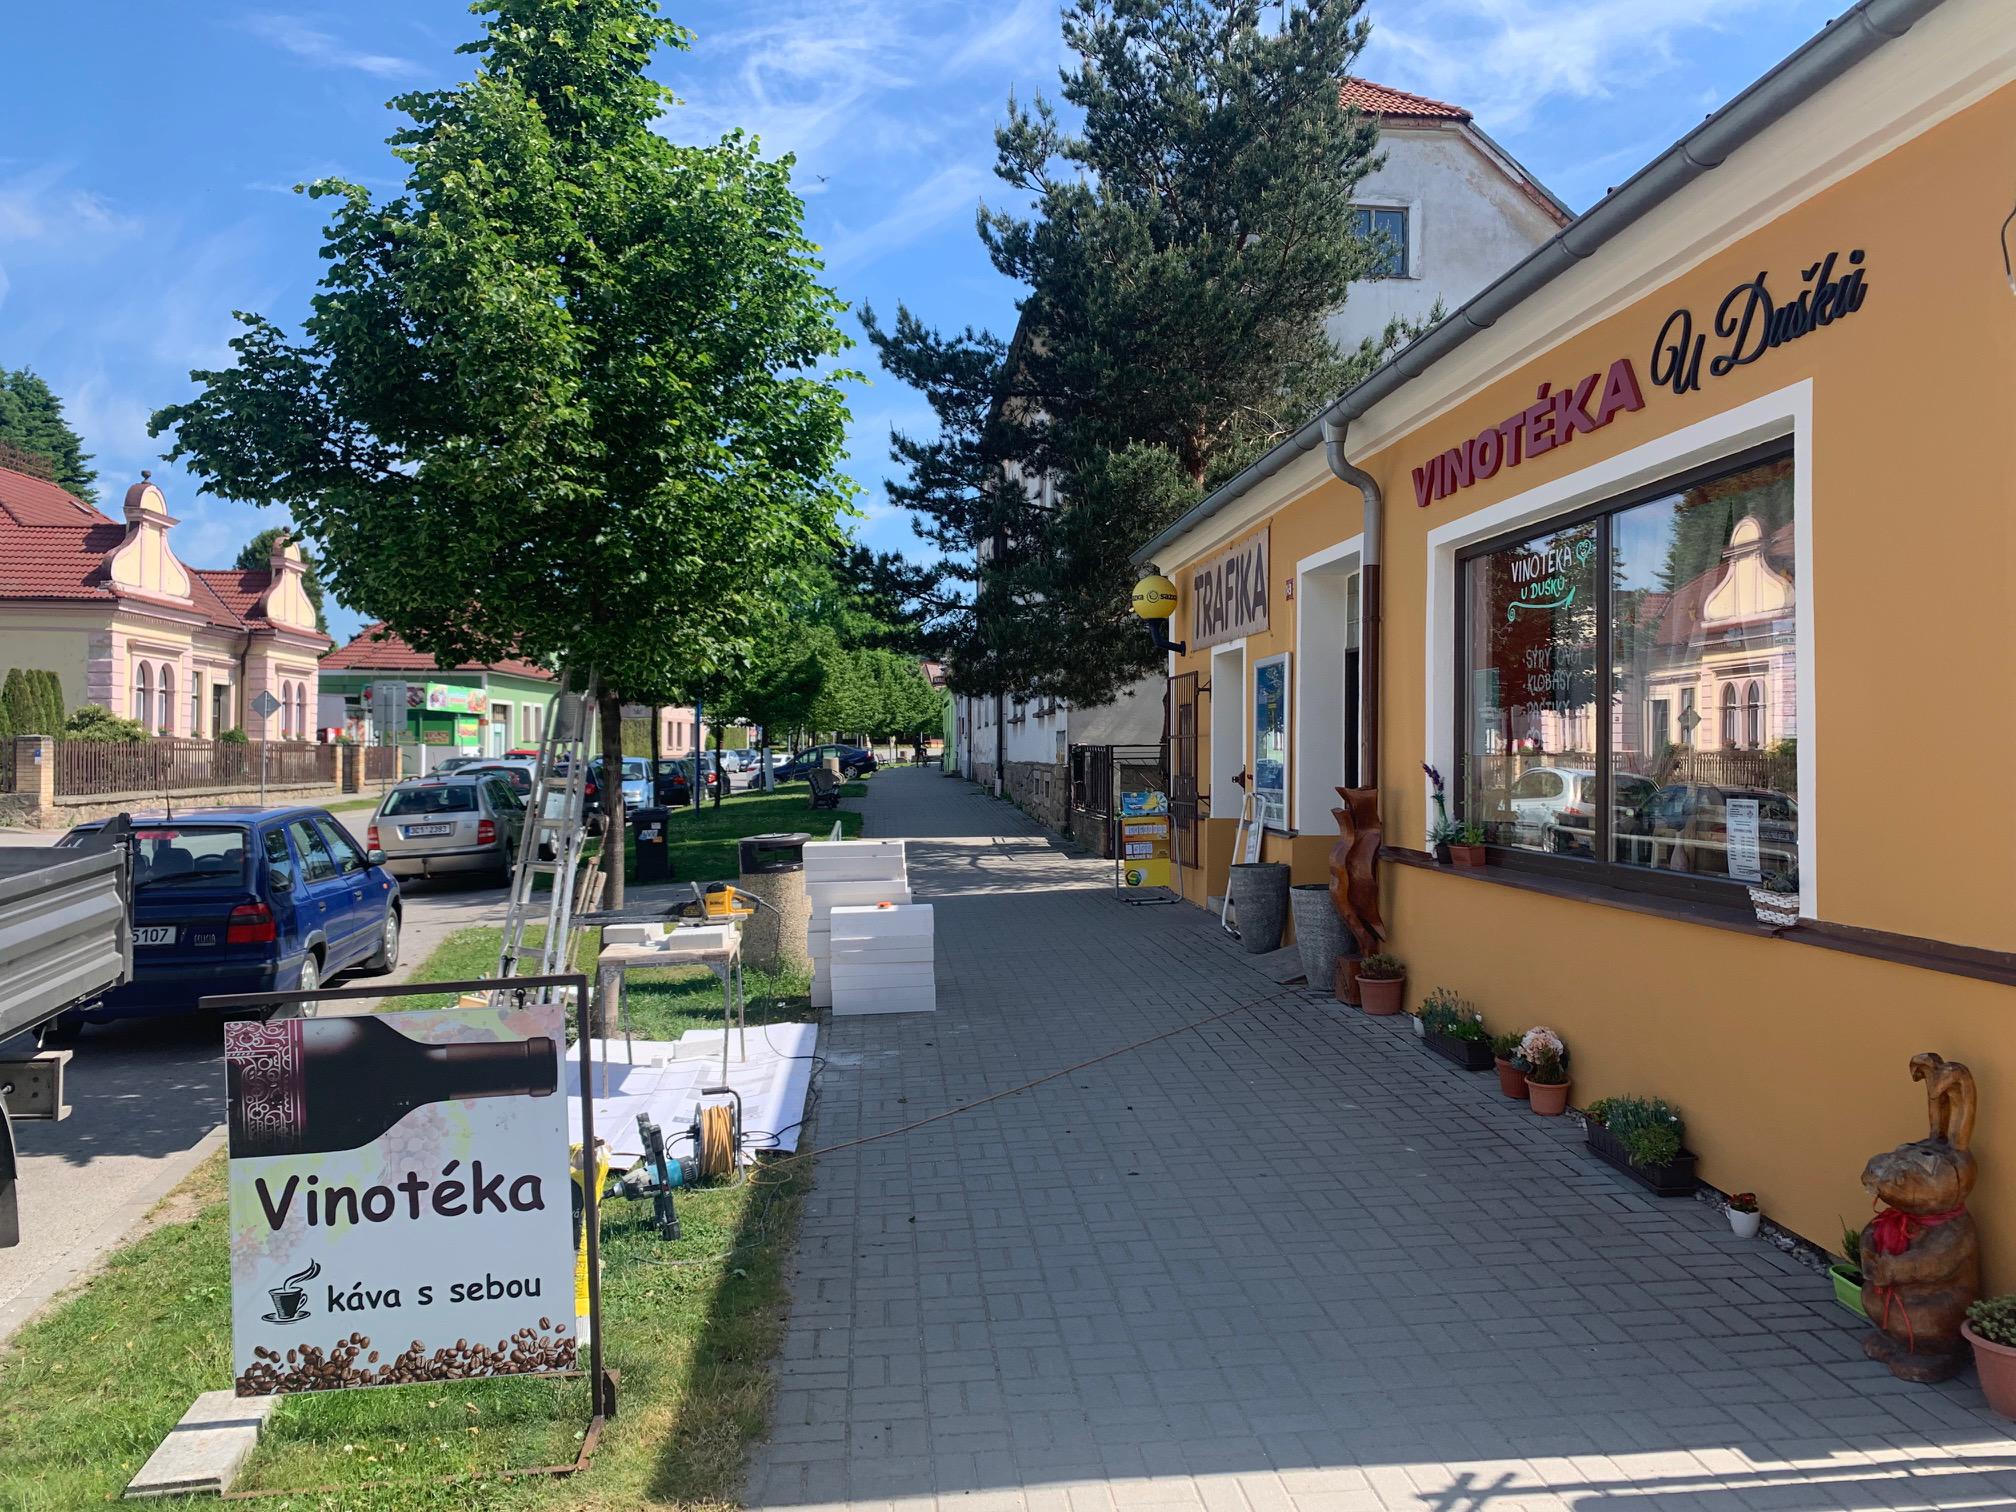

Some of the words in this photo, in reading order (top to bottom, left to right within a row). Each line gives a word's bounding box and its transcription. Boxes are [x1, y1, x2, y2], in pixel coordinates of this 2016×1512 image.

[1650, 309, 1707, 395] U
[1411, 359, 1645, 508] VINOTÉKA
[1194, 542, 1267, 640] TRAFIKA
[255, 1159, 545, 1231] Vinotéka
[327, 1281, 401, 1313] káva
[418, 1285, 434, 1305] s
[449, 1273, 542, 1304] sebou
